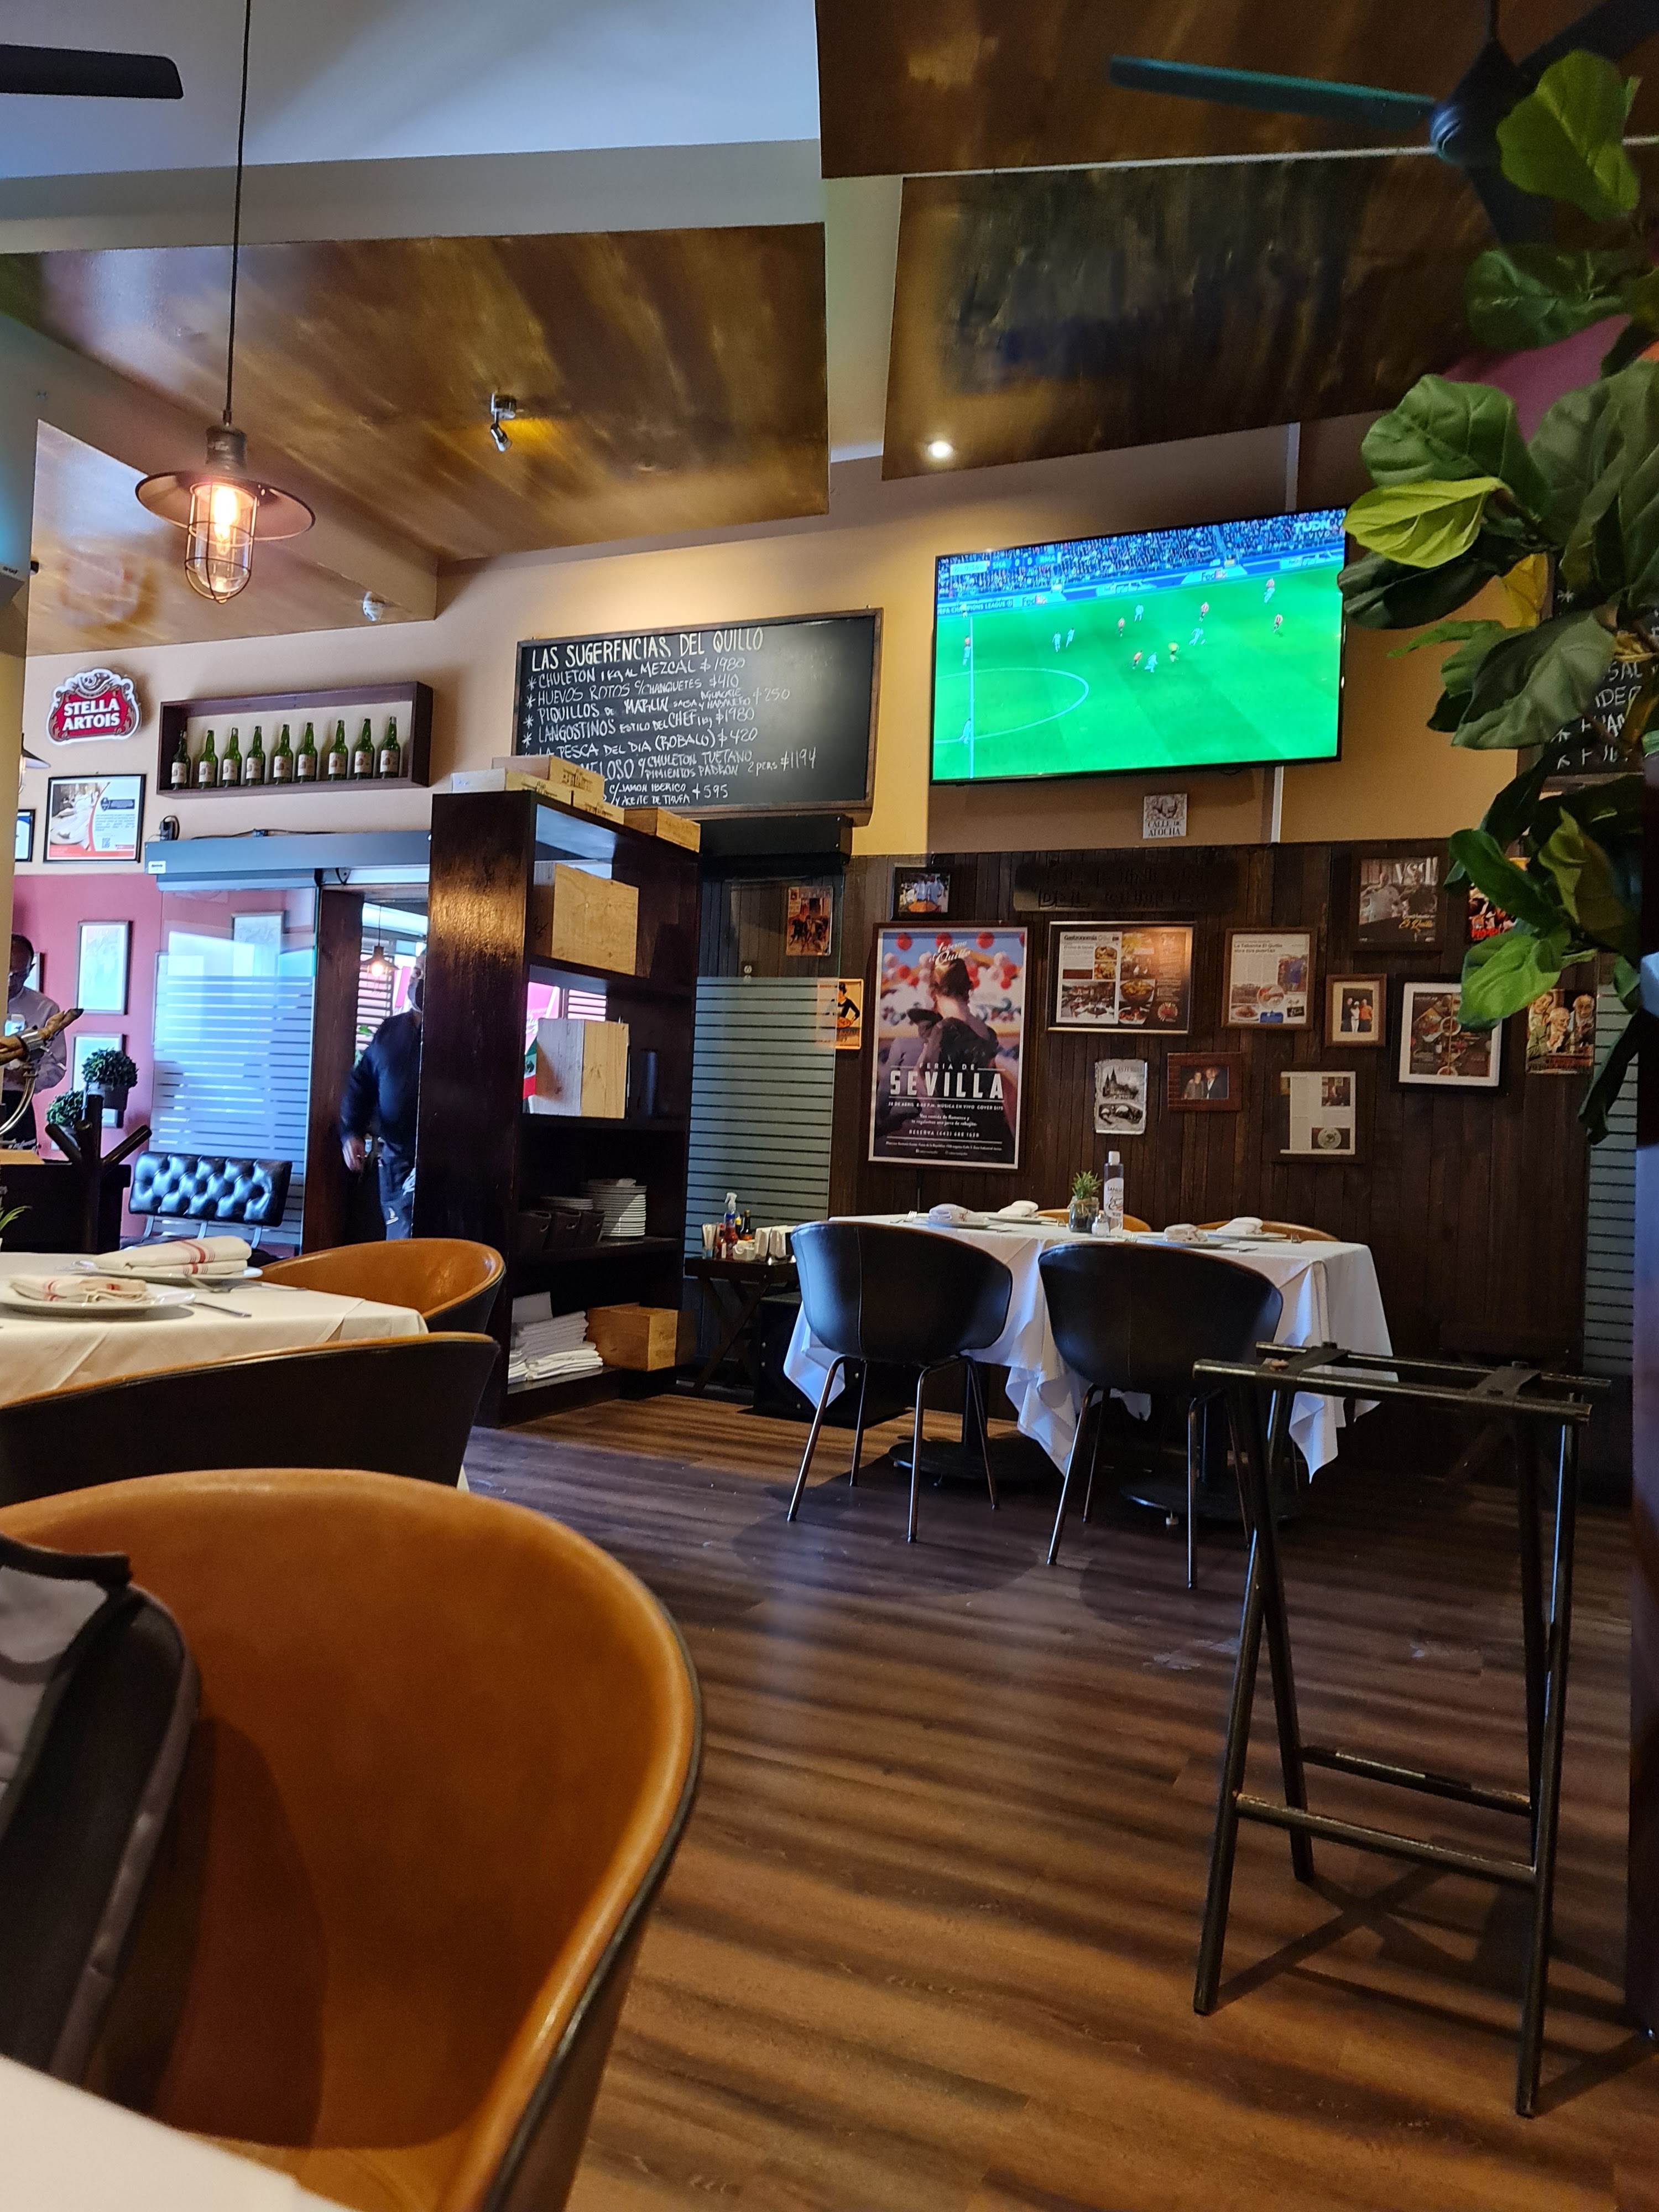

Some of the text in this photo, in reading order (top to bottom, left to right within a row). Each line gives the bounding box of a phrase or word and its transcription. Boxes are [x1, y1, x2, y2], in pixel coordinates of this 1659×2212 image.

[1201, 568, 1227, 581] FedEx
[1022, 594, 1047, 607] FedEx
[532, 627, 764, 672] LAS SUGERENCIAS DEL QUILLO
[538, 667, 596, 689] CHULETON
[625, 668, 638, 678] AL
[640, 659, 696, 678] MEZCAL
[538, 686, 583, 706] HUEVOS
[589, 682, 630, 701] ROTOS
[64, 698, 121, 716] STELLA
[536, 703, 600, 725] PIQUILLOS
[624, 696, 669, 714] MARLIN
[62, 712, 121, 731] ARTOIS
[538, 719, 616, 743] LANGOSTINOS
[619, 722, 650, 733] ESTILO
[668, 709, 697, 728] CHEF
[556, 743, 600, 759] PESCA
[603, 743, 626, 756] DEL
[628, 740, 651, 753] DIA
[644, 768, 696, 781] PIMIENTOS
[1148, 828, 1180, 837] ATOCHA
[919, 1062, 975, 1071] FERIA DE
[890, 1070, 1004, 1099] SEVILLA
